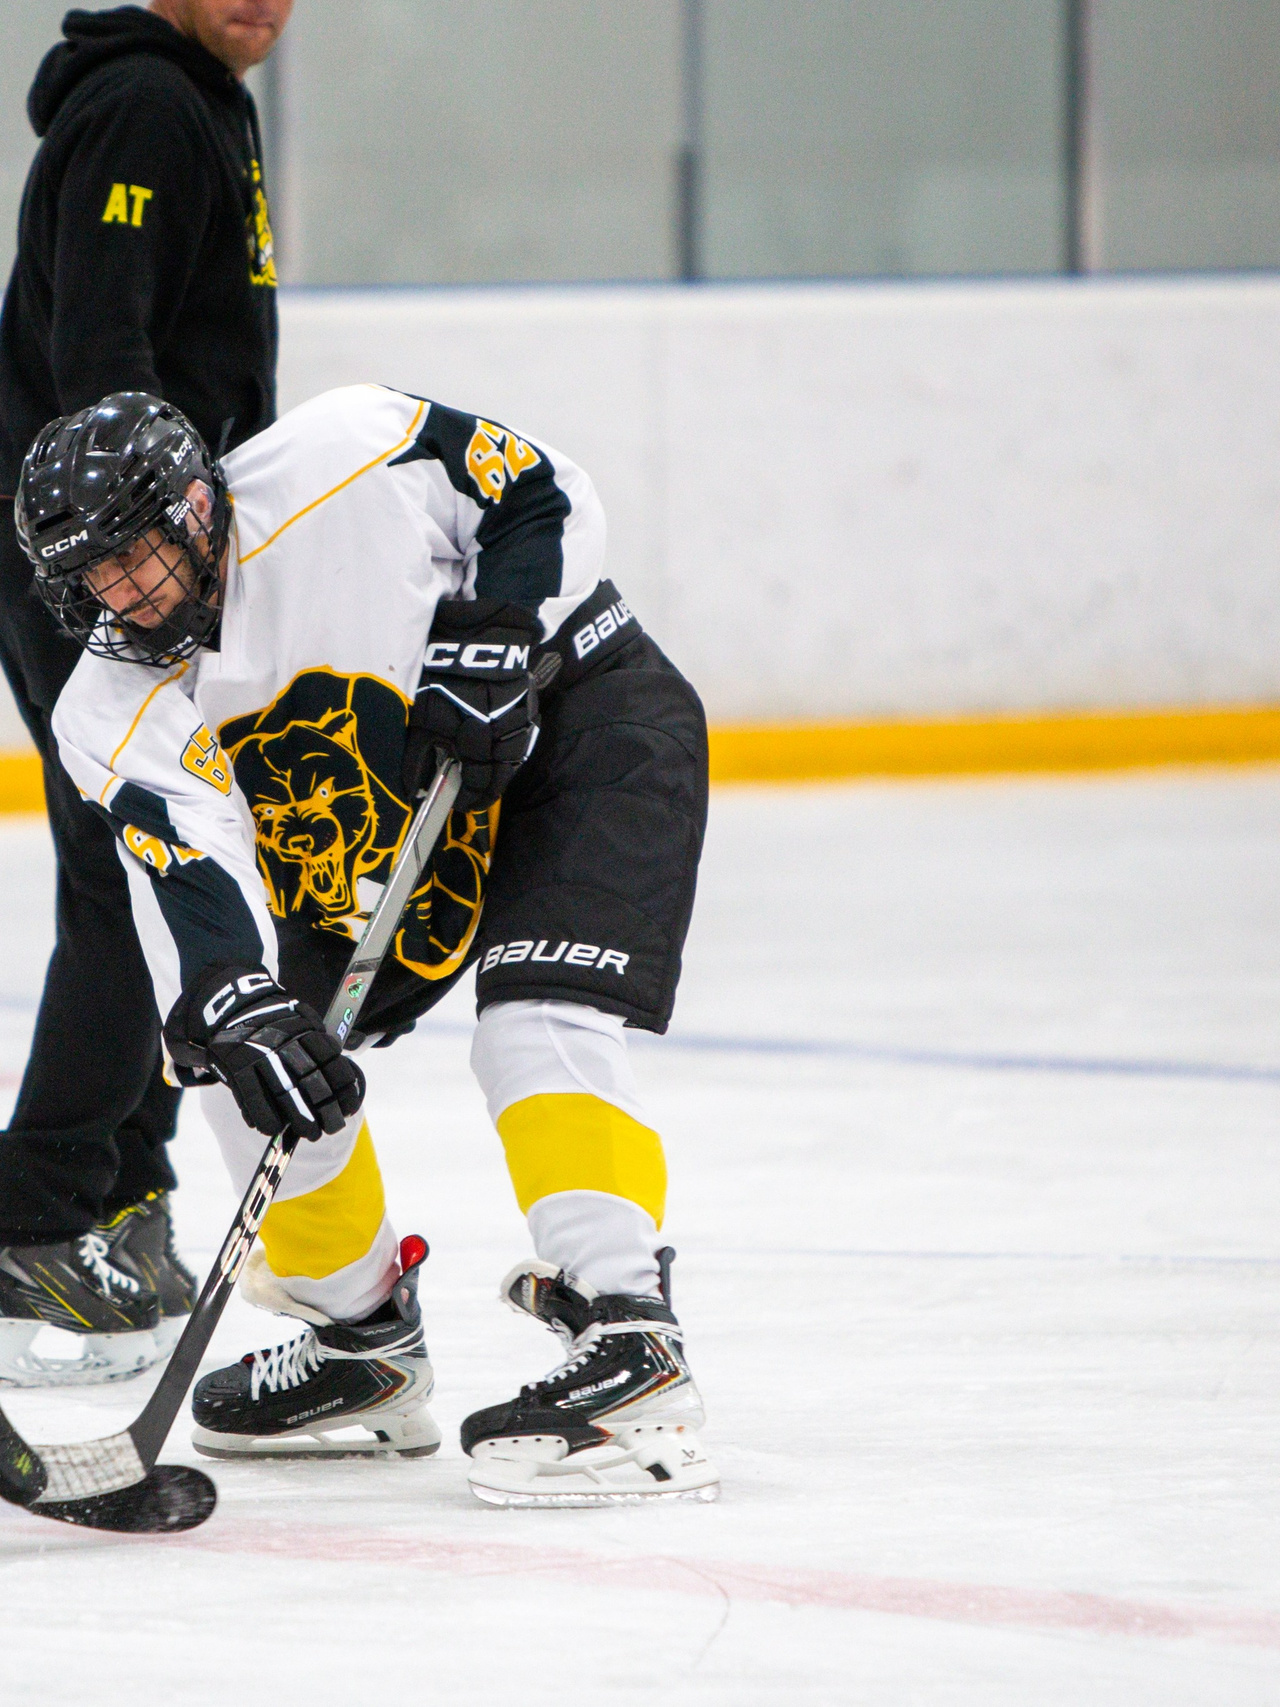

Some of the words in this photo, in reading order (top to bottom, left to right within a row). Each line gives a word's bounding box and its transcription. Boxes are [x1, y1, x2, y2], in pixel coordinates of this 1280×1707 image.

[102, 183, 153, 228] AT
[465, 418, 541, 504] 62
[40, 529, 89, 558] CCM
[423, 642, 530, 670] CCM
[479, 939, 630, 976] BAUER
[286, 1396, 345, 1425] BAUER
